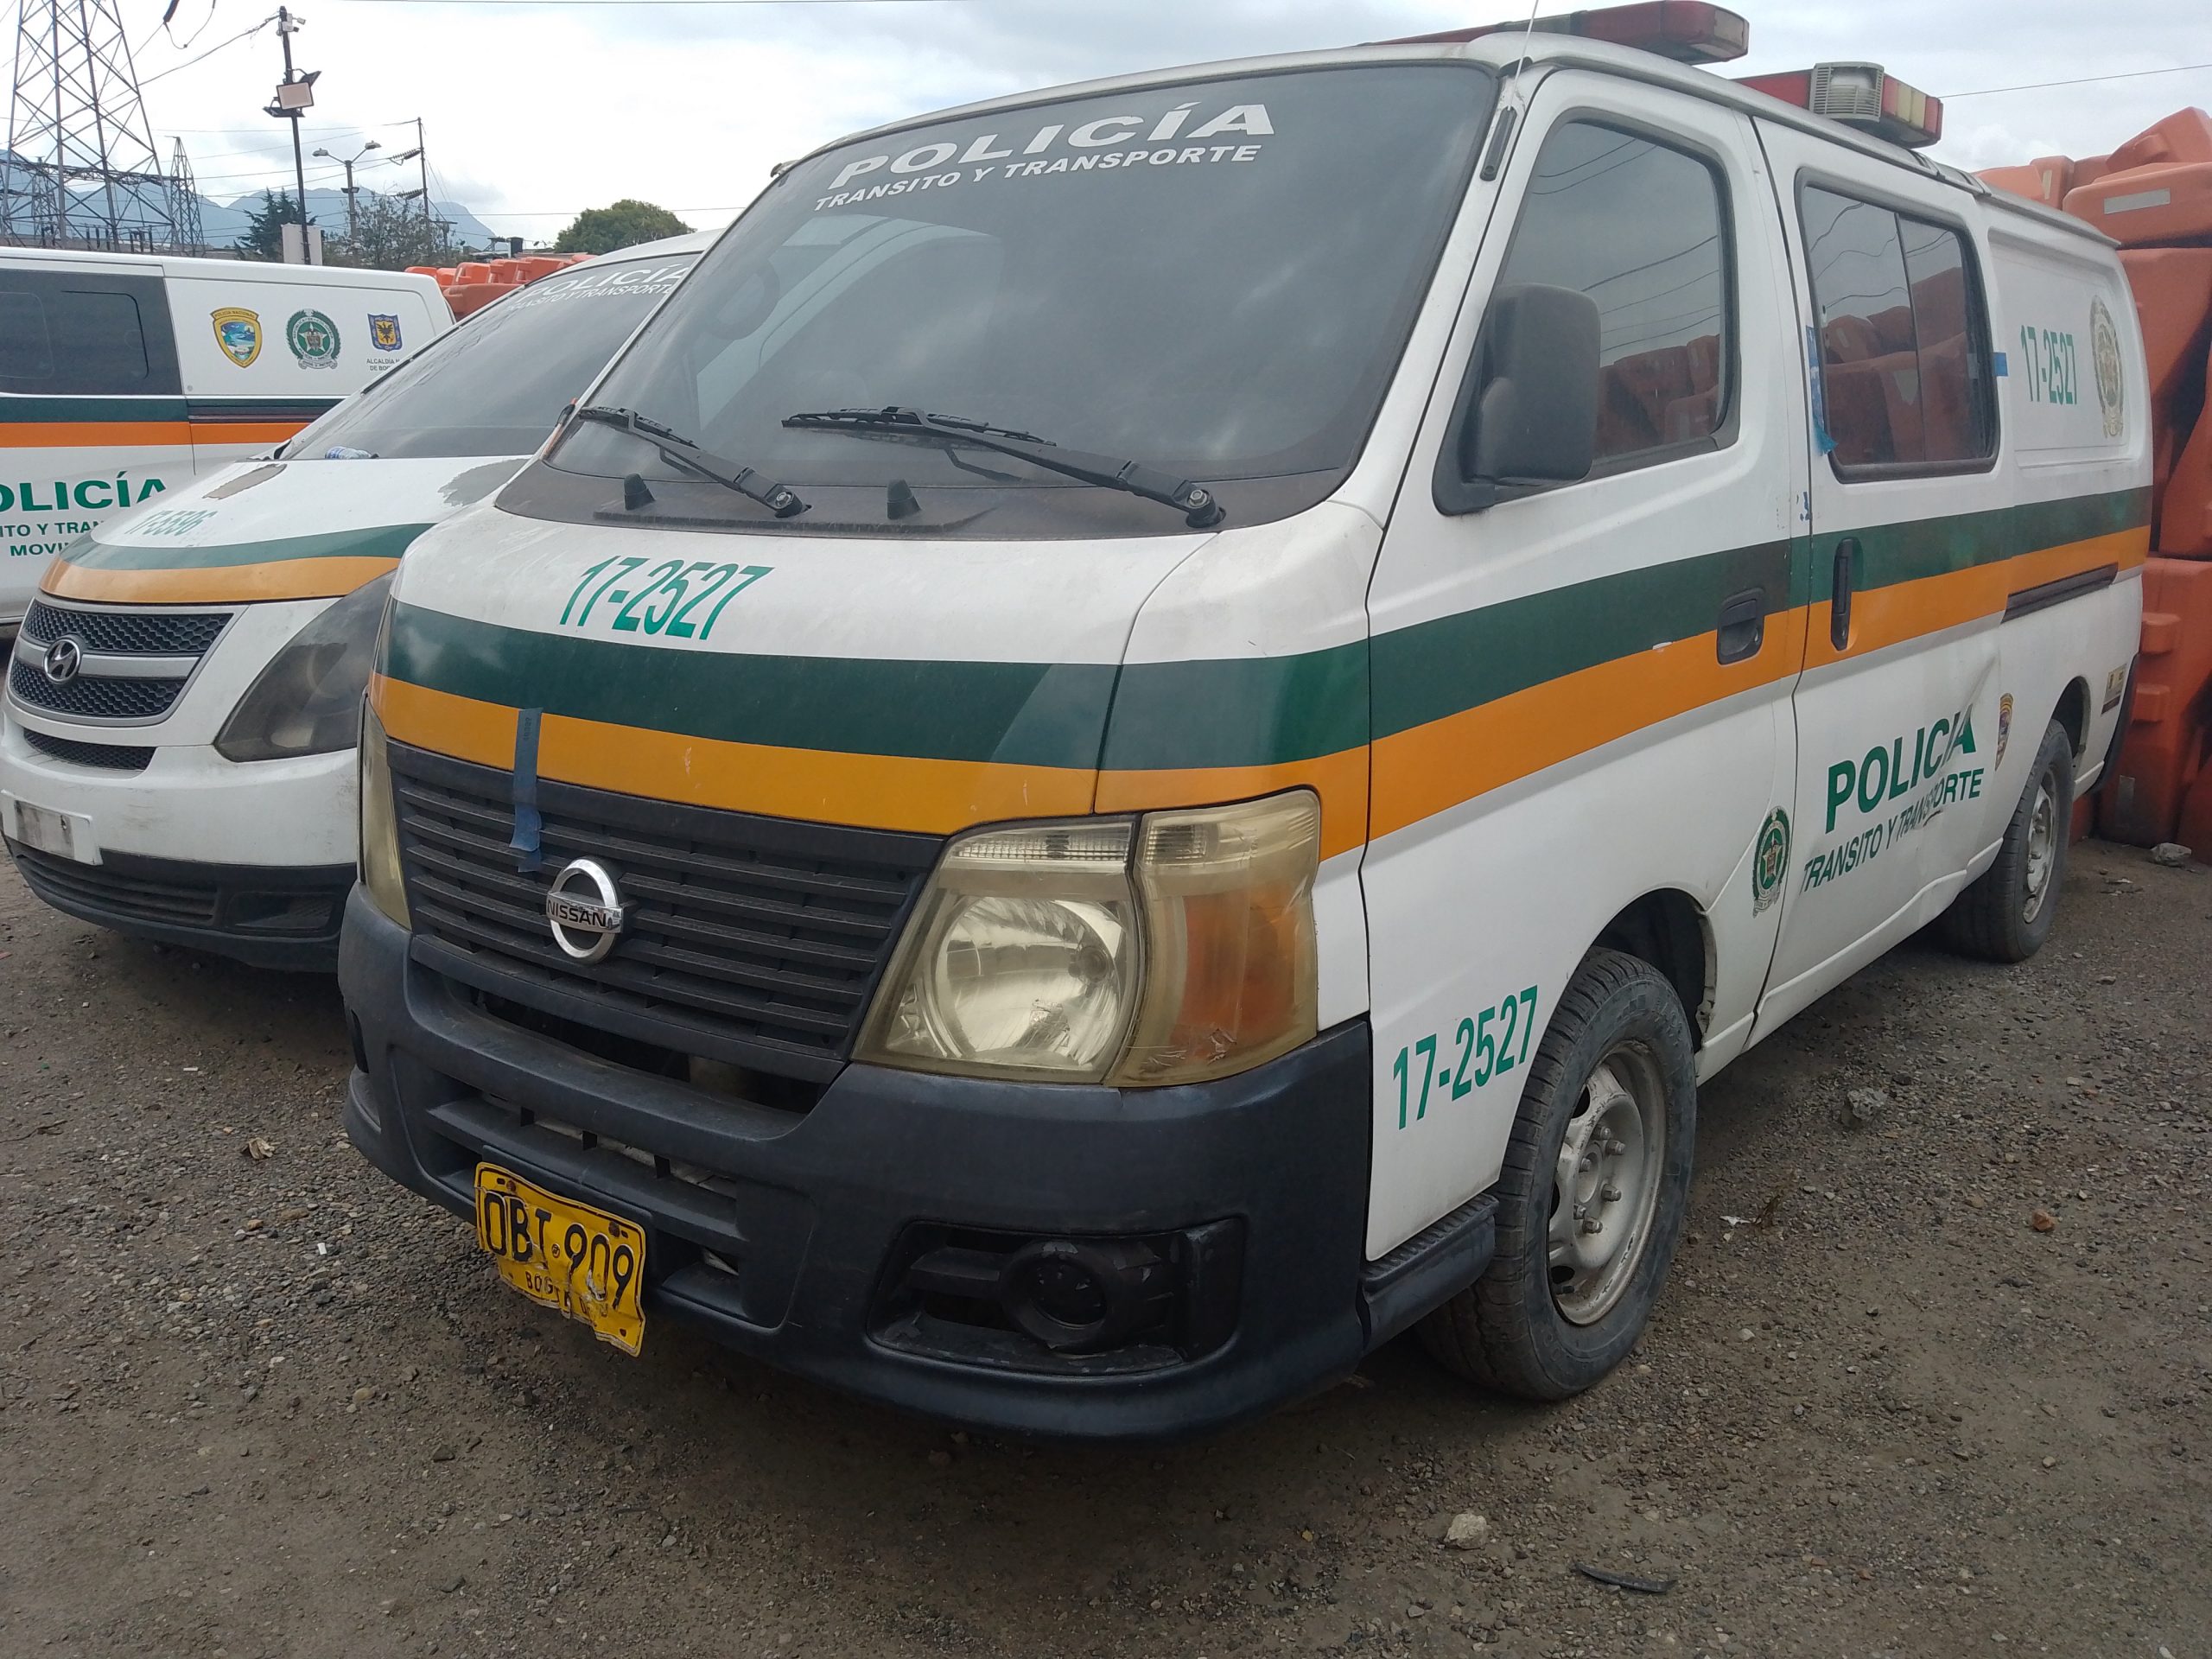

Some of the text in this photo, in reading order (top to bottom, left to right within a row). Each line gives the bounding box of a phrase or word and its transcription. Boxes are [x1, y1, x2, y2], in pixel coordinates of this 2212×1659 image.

[814, 145, 1262, 211] TRANSITO Y TRANSPORTE
[828, 102, 1274, 190] POLICÍA
[2021, 325, 2077, 405] 17-2527
[10, 542, 69, 556] MOVI
[36, 523, 49, 535] Y
[560, 556, 776, 639] 17-2527
[1799, 823, 1884, 895] TRANSITO
[1885, 815, 1898, 850] Y
[547, 899, 607, 927] NISSAN
[1393, 984, 1538, 1131] 17-2527
[564, 1222, 635, 1311] 909
